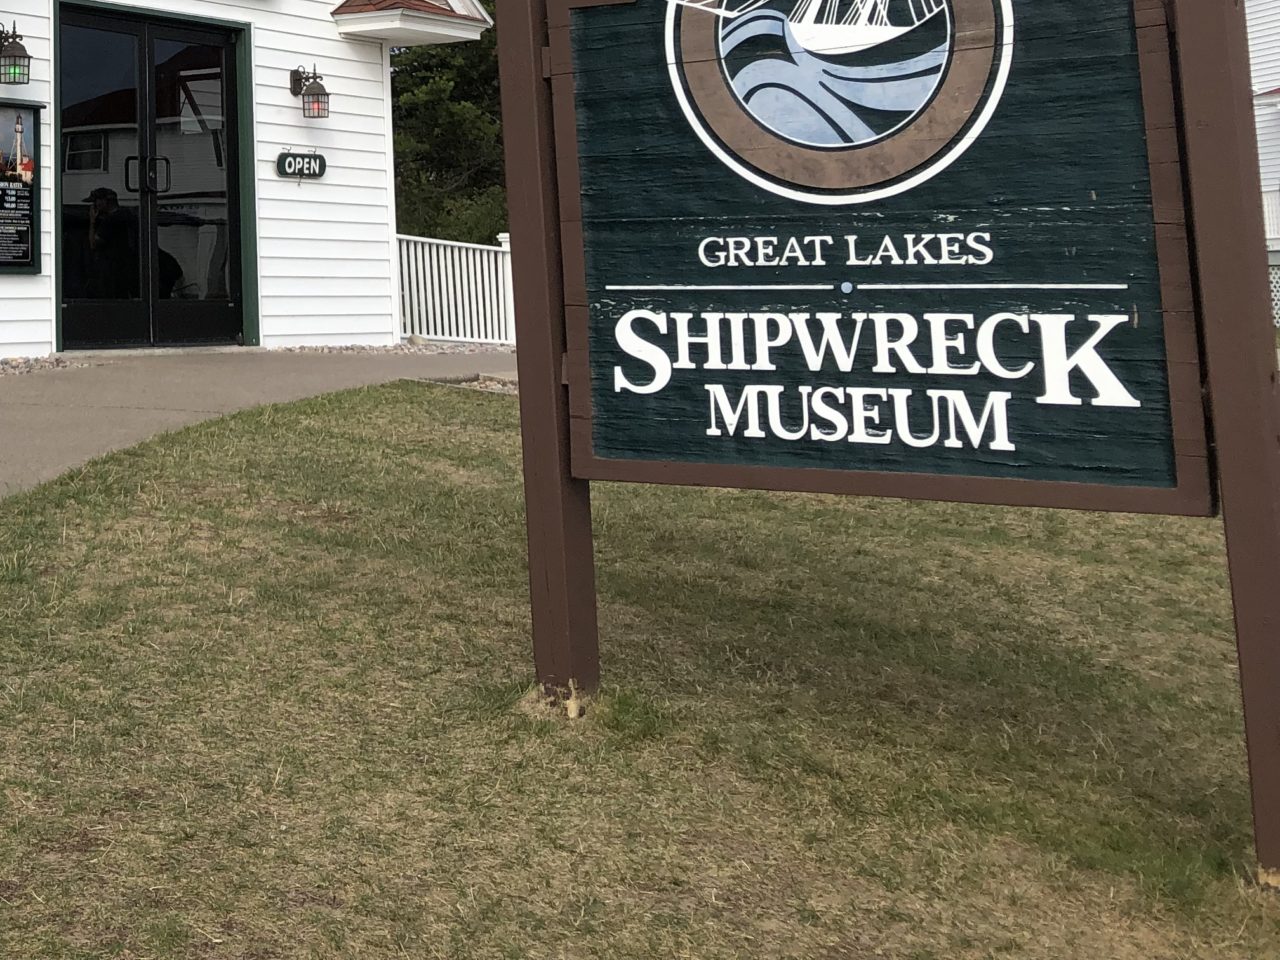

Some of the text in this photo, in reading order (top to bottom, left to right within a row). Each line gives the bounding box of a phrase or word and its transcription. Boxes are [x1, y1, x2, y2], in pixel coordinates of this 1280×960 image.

[285, 157, 319, 174] OPEN
[698, 232, 994, 266] GREAT LAKES
[613, 308, 1141, 408] SHIPWRECK
[704, 383, 1016, 451] MUSEUM
